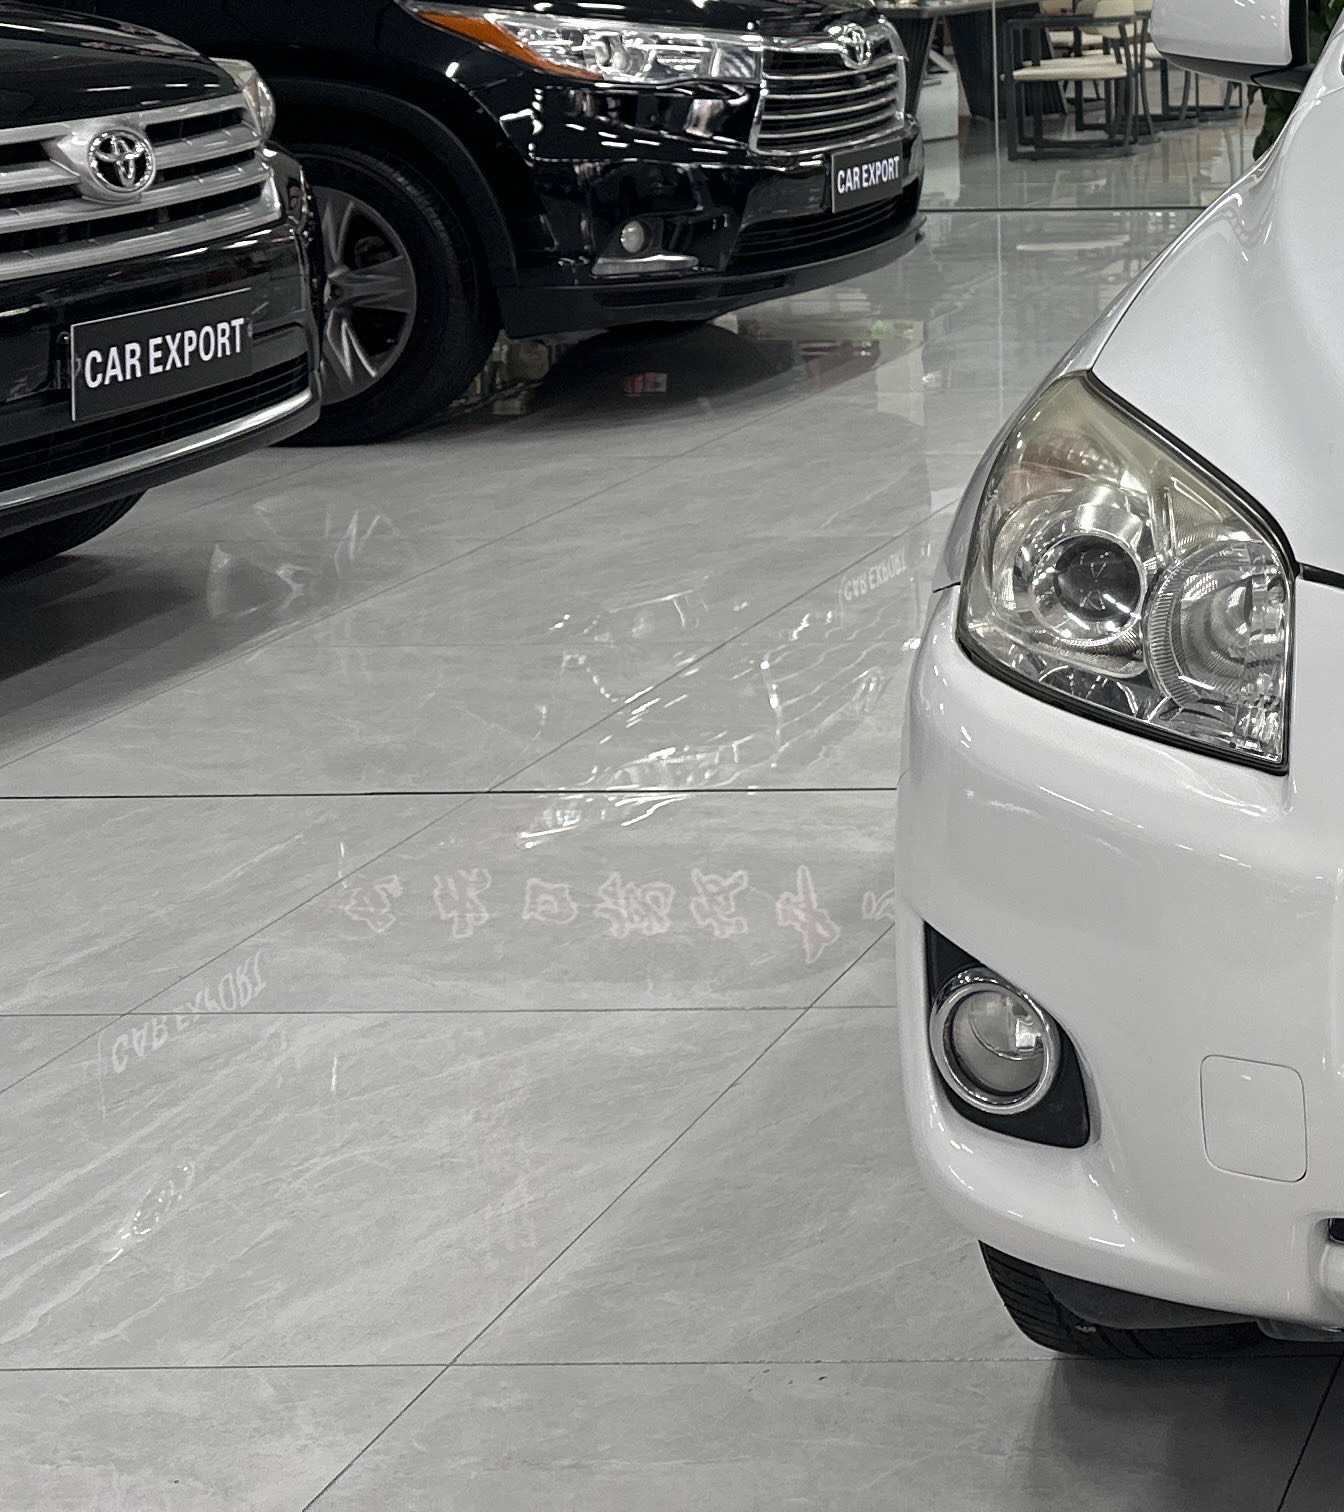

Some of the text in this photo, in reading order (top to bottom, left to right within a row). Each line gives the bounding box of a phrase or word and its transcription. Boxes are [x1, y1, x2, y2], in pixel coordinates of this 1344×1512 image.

[837, 155, 900, 194] CAR EXPORT
[84, 317, 246, 389] CAR EXPORT
